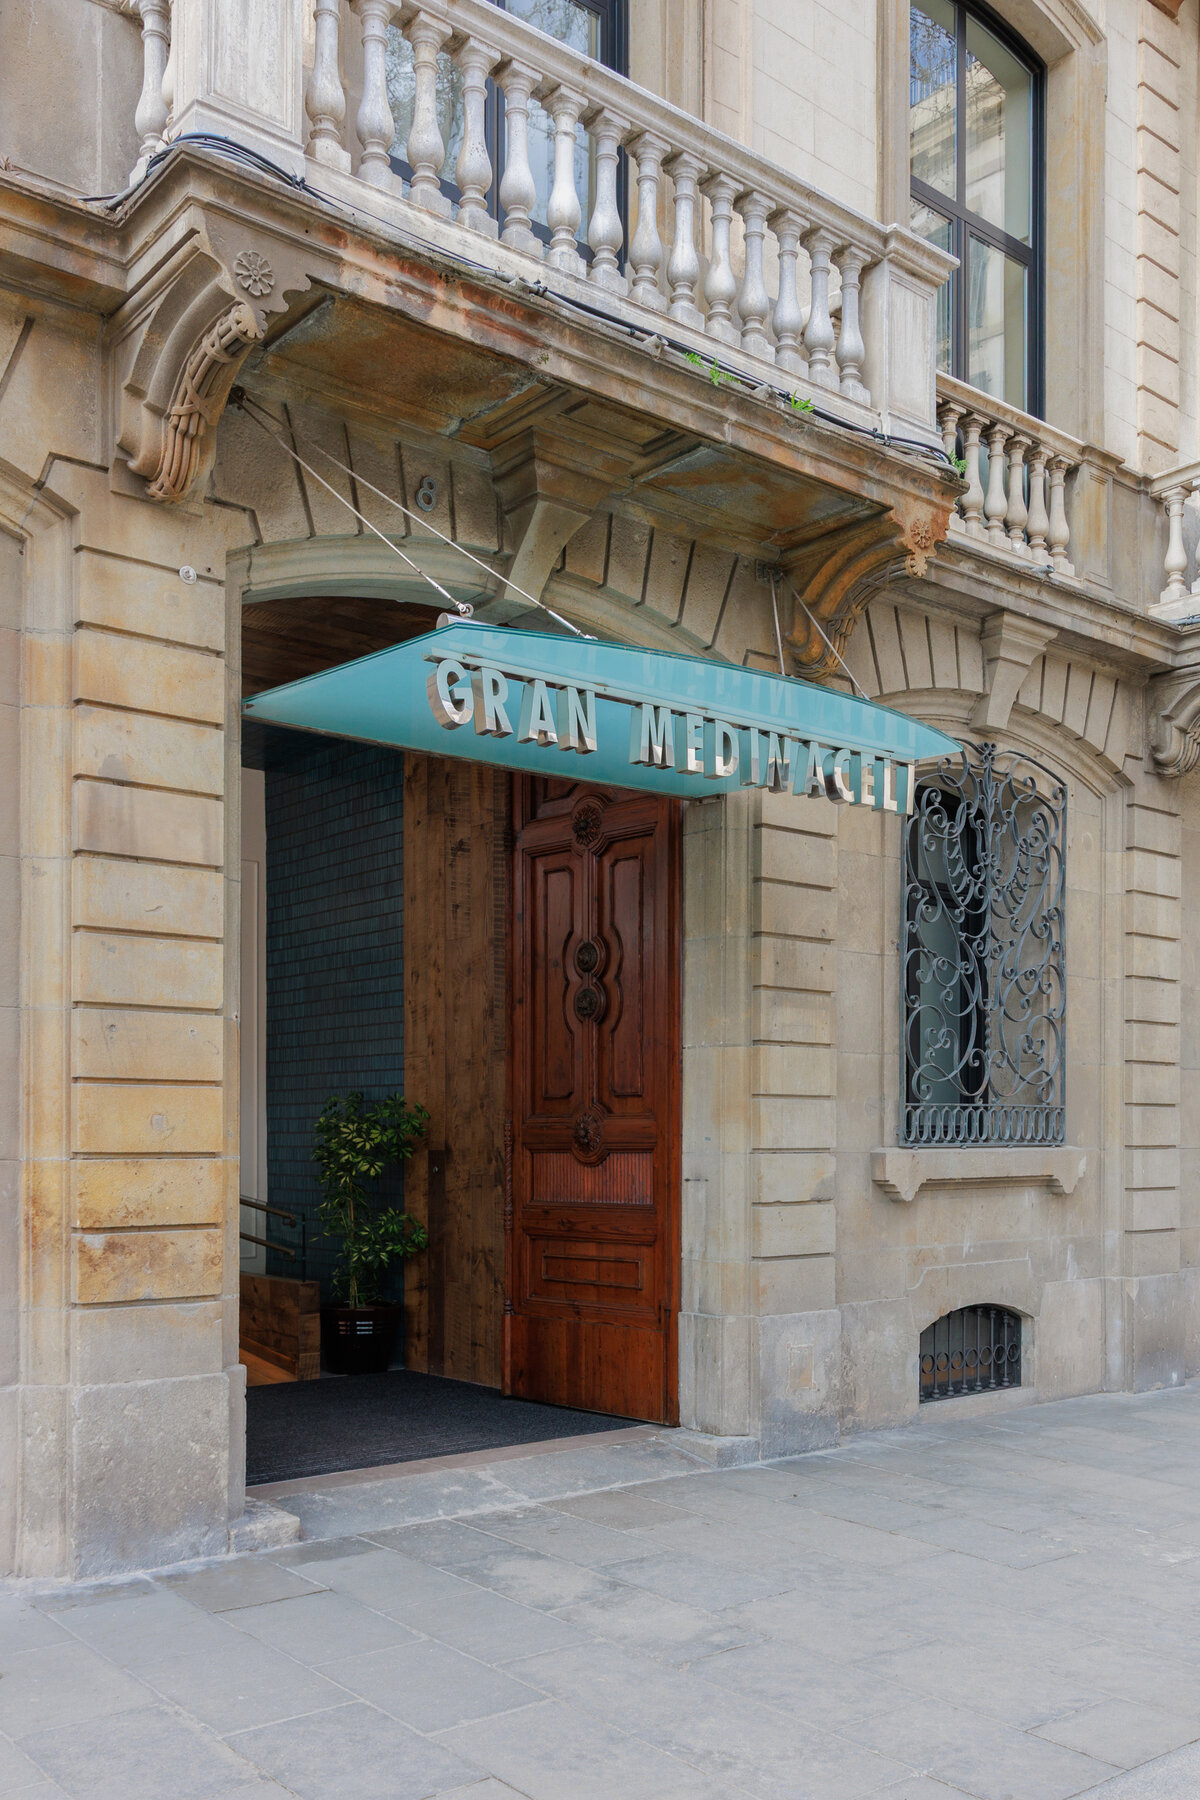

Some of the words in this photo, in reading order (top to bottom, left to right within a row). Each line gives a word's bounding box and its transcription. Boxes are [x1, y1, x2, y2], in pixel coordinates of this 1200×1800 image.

[416, 476, 438, 512] 8
[427, 659, 598, 754] GRAN
[629, 703, 915, 815] MEDINACELI
